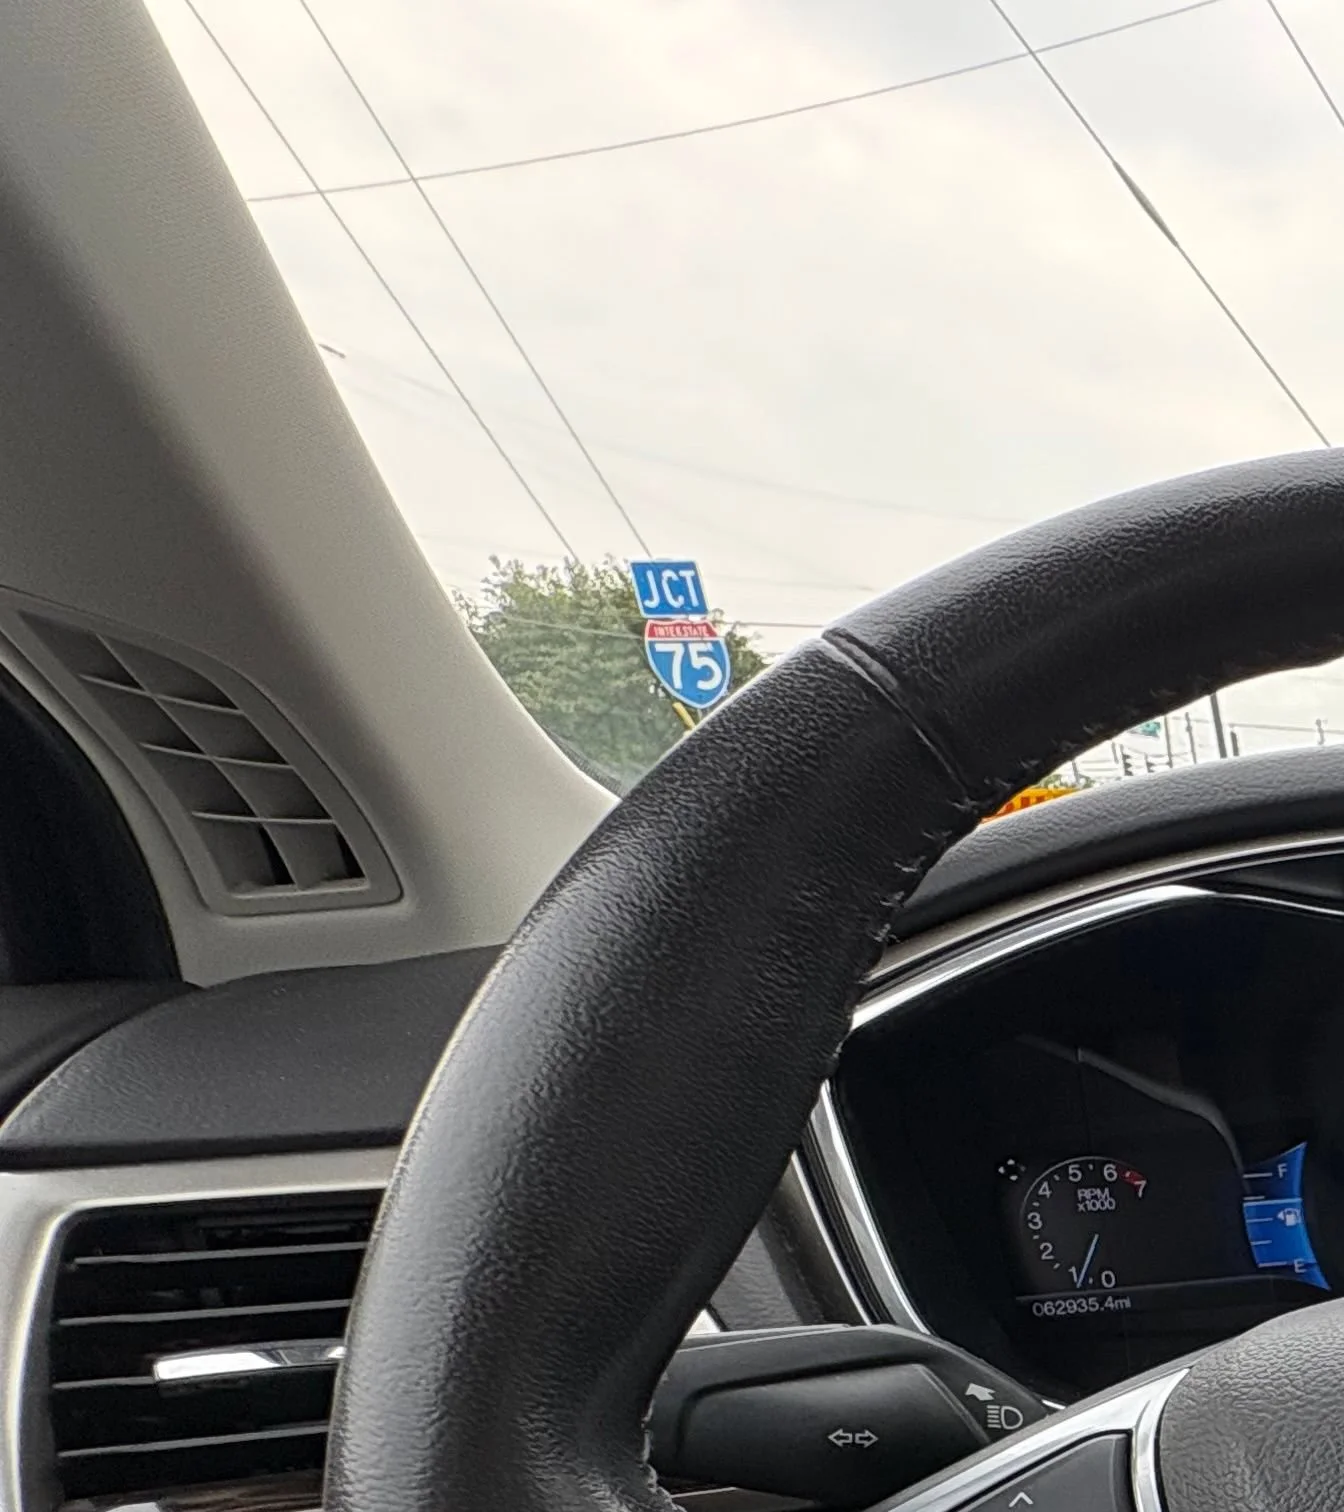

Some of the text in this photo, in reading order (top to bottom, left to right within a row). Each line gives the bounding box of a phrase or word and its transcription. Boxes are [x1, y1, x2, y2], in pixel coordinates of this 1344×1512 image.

[644, 569, 700, 609] JCT
[654, 625, 710, 637] INTERSTATE
[655, 643, 722, 690] 75
[1069, 1166, 1082, 1183] 5
[1103, 1164, 1118, 1182] 6
[1277, 1163, 1288, 1178] F
[1038, 1181, 1052, 1198] 4
[1077, 1187, 1110, 1201] RPM
[1135, 1180, 1146, 1198] 7
[1077, 1198, 1116, 1213] x1000
[1027, 1212, 1042, 1230] 3
[1040, 1243, 1055, 1260] 2
[1069, 1266, 1078, 1282] 1
[1294, 1259, 1305, 1274] E
[1101, 1270, 1116, 1288] 0
